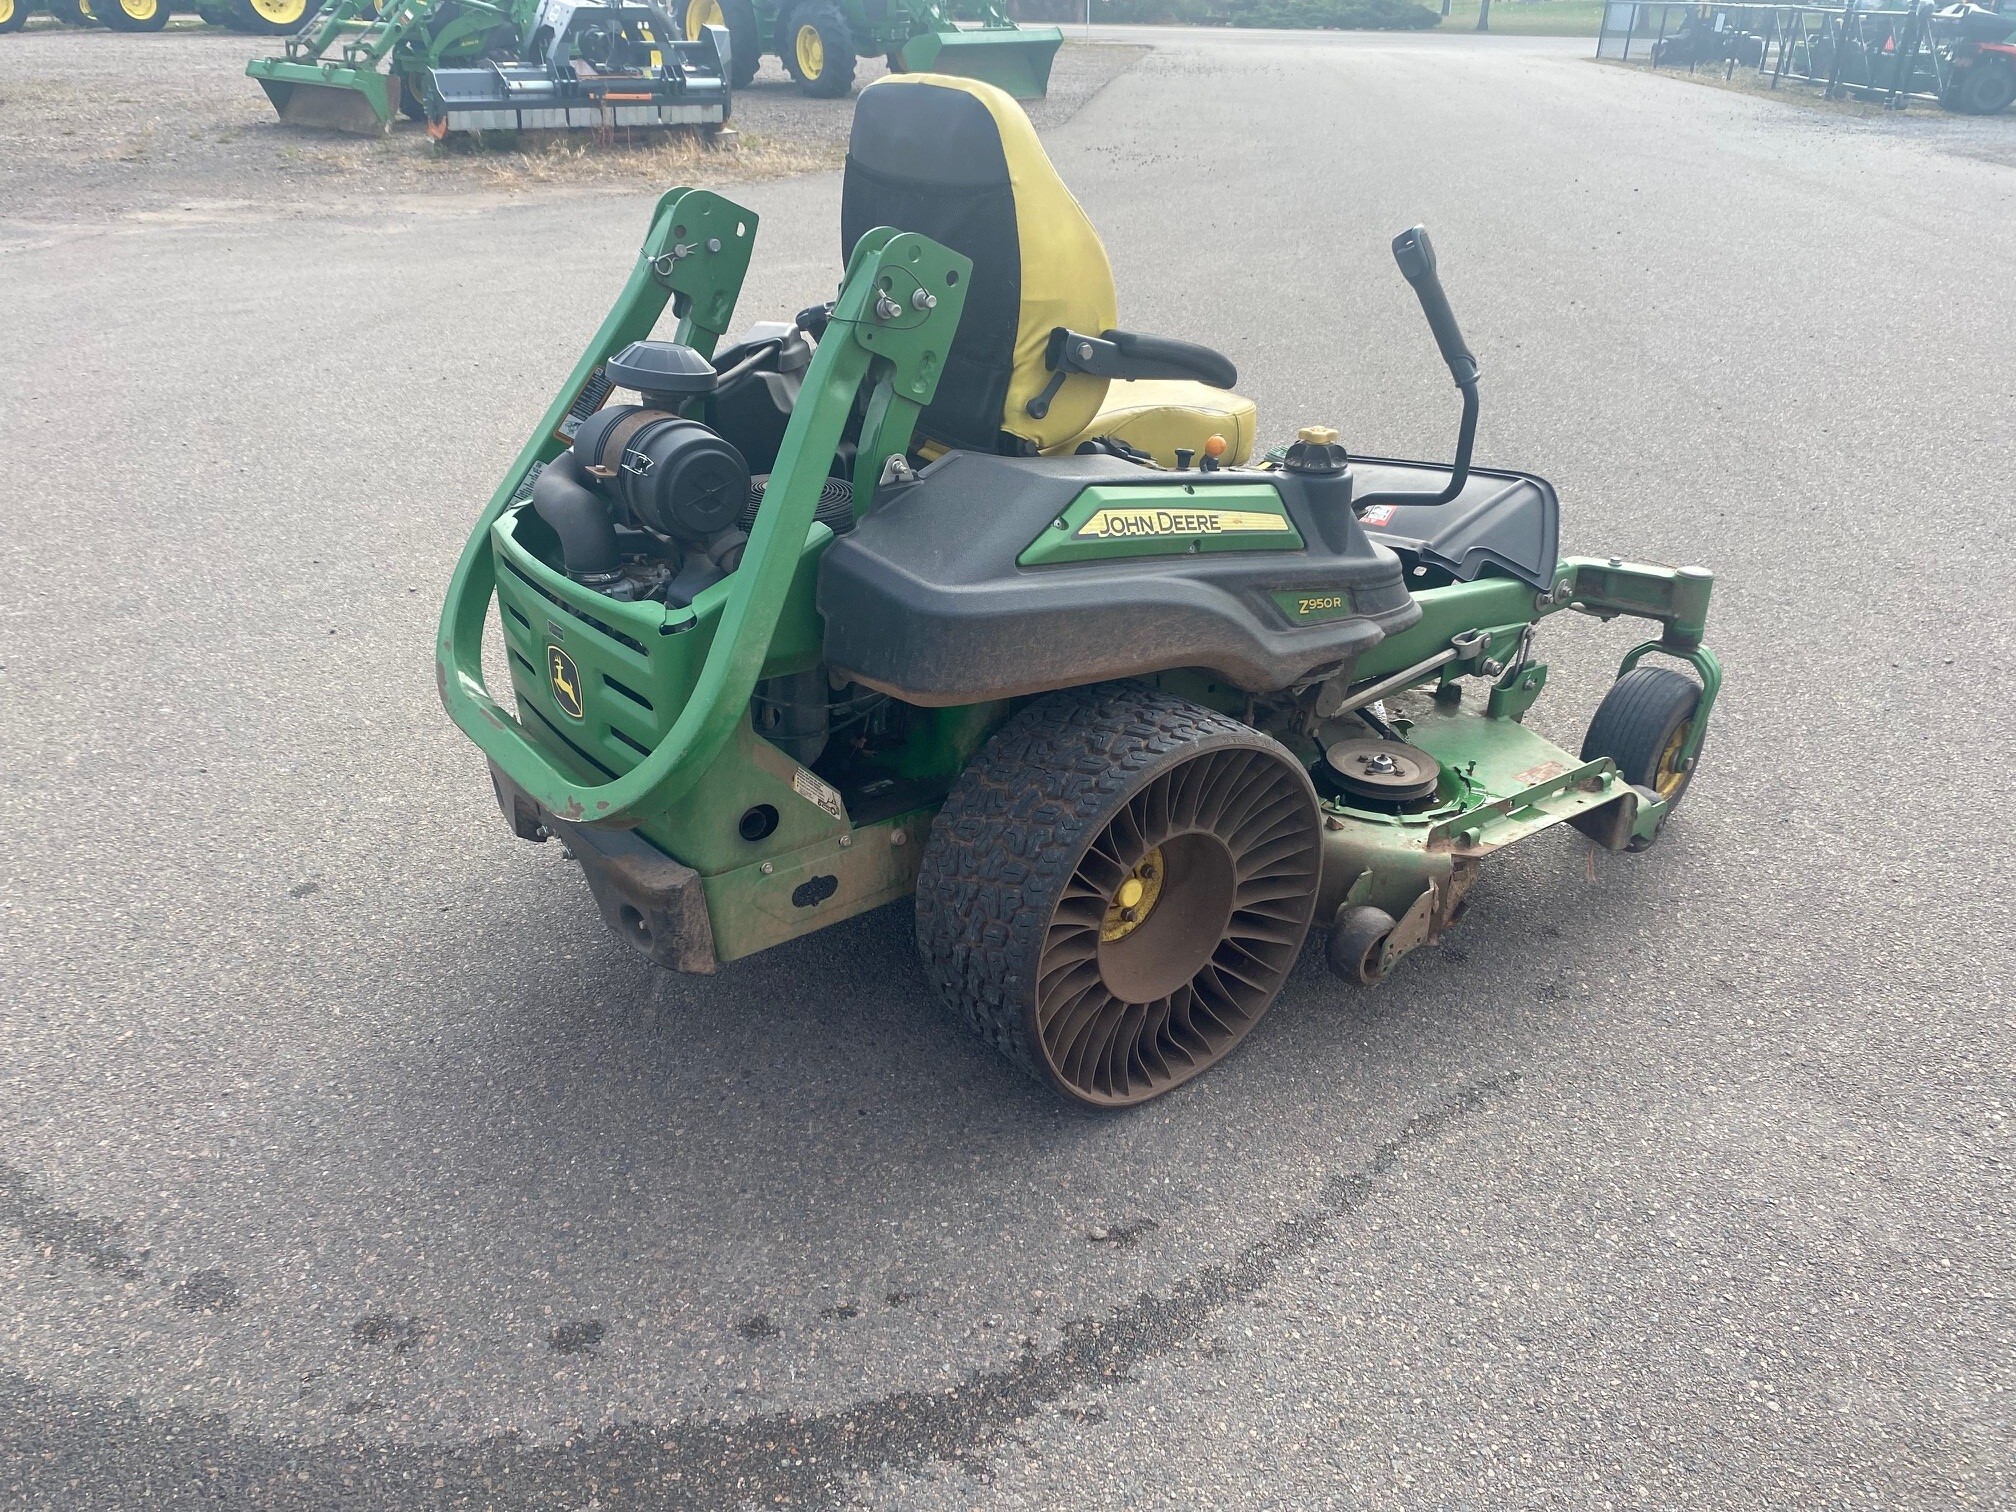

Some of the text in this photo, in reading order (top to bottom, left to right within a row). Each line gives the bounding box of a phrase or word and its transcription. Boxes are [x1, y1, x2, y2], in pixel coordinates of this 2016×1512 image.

[1099, 511, 1221, 535] JOHN DEERE
[1298, 597, 1342, 614] Z950R
